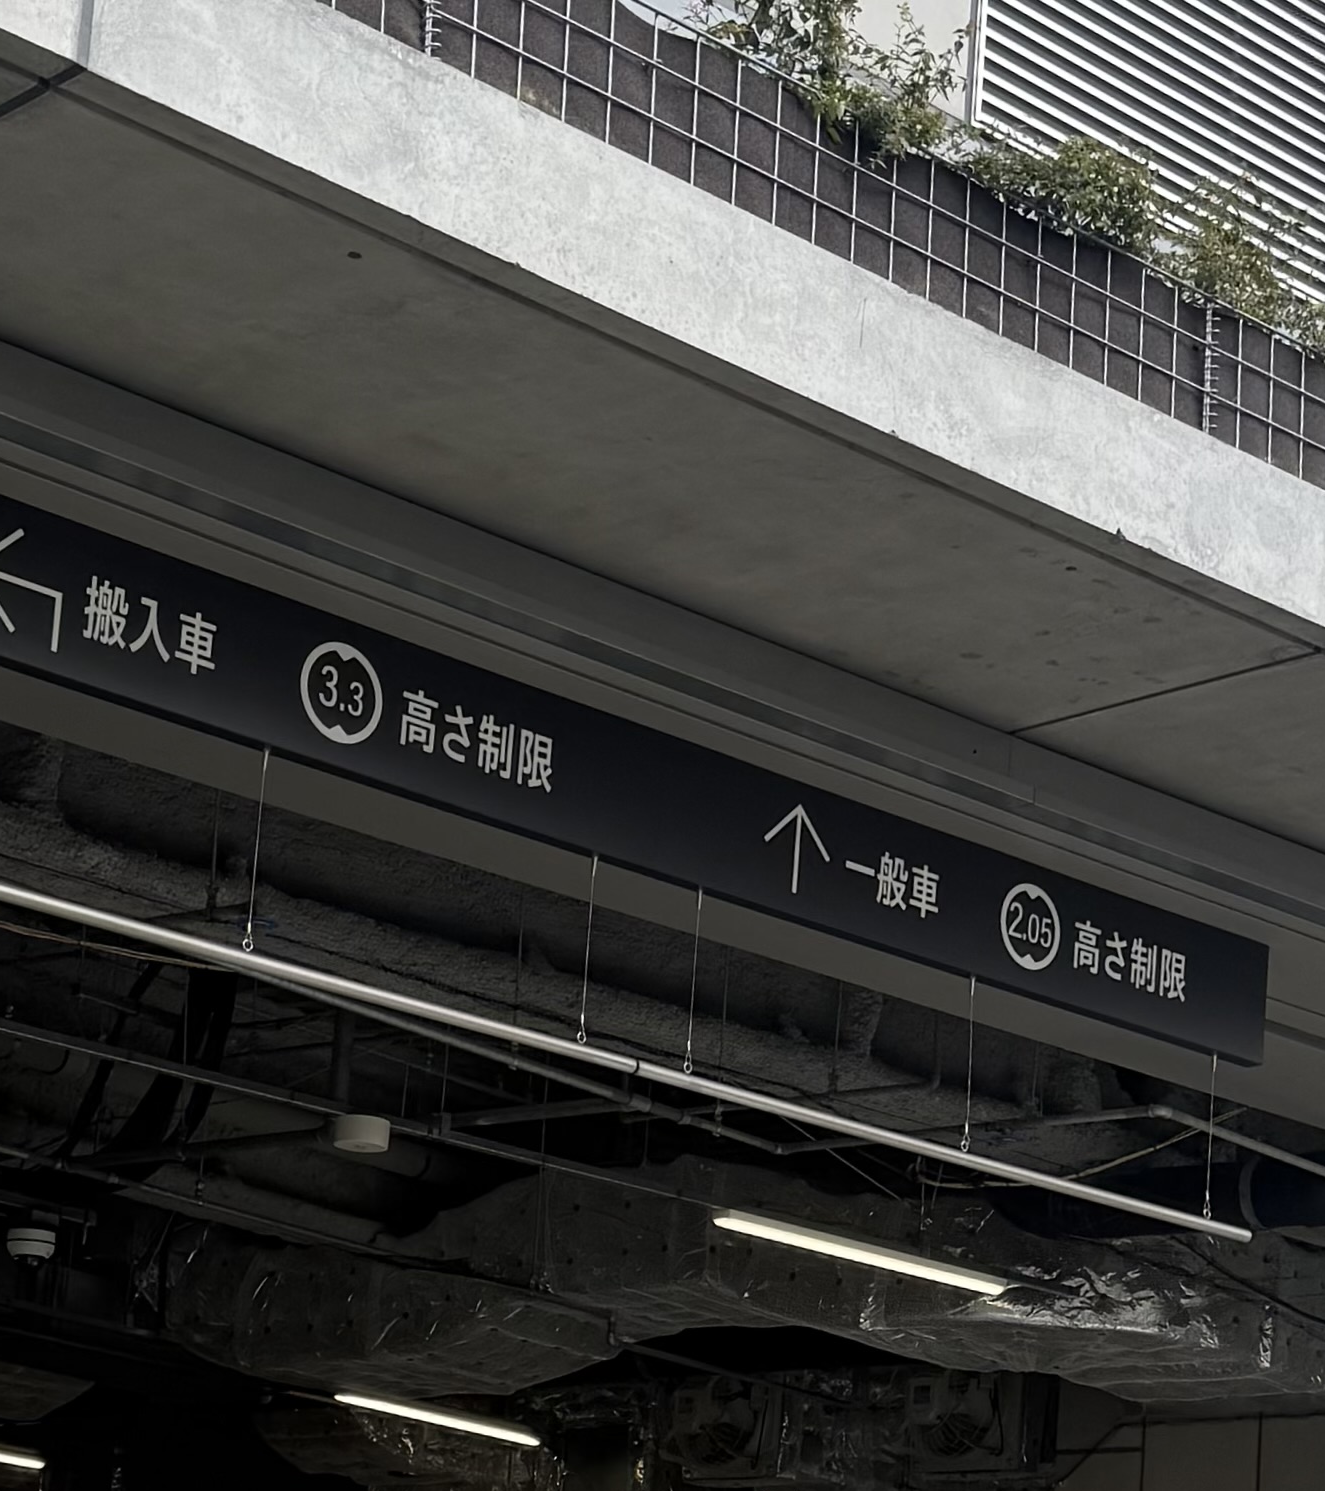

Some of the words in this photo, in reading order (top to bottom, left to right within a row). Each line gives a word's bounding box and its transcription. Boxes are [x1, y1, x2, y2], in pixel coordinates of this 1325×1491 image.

[82, 575, 217, 675] 搬入車
[316, 665, 365, 718] 3.3
[399, 689, 554, 794] 高さ制限
[844, 851, 940, 919] 一般車
[1008, 902, 1053, 948] 2.05
[1073, 920, 1186, 1002] 高さ制限
